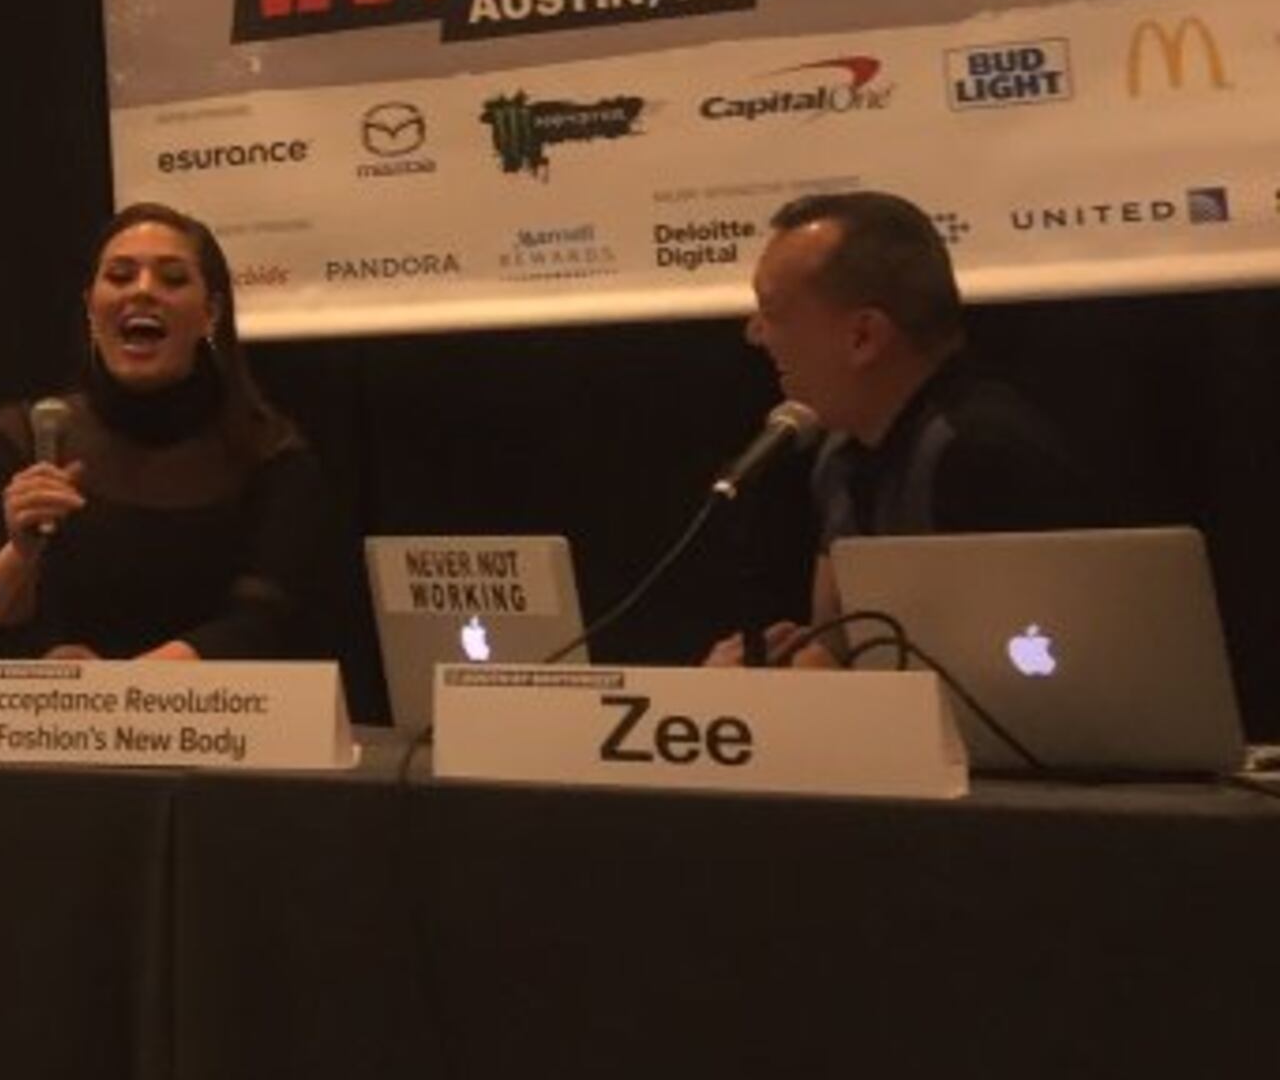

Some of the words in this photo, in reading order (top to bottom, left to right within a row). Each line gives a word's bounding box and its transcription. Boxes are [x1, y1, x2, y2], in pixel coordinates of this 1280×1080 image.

[968, 48, 1044, 75] BUD
[955, 71, 1062, 103] LIGHT
[157, 139, 308, 173] esurance
[1012, 200, 1176, 230] UNITED
[325, 253, 460, 281] PANDORA
[656, 244, 737, 271] Digital
[405, 550, 471, 578] NEVER
[476, 550, 519, 578] NOT
[410, 583, 527, 613] WORKING
[124, 687, 269, 716] Revolution:
[114, 728, 174, 754] New
[180, 728, 247, 761] Body
[599, 695, 753, 766] Zee
